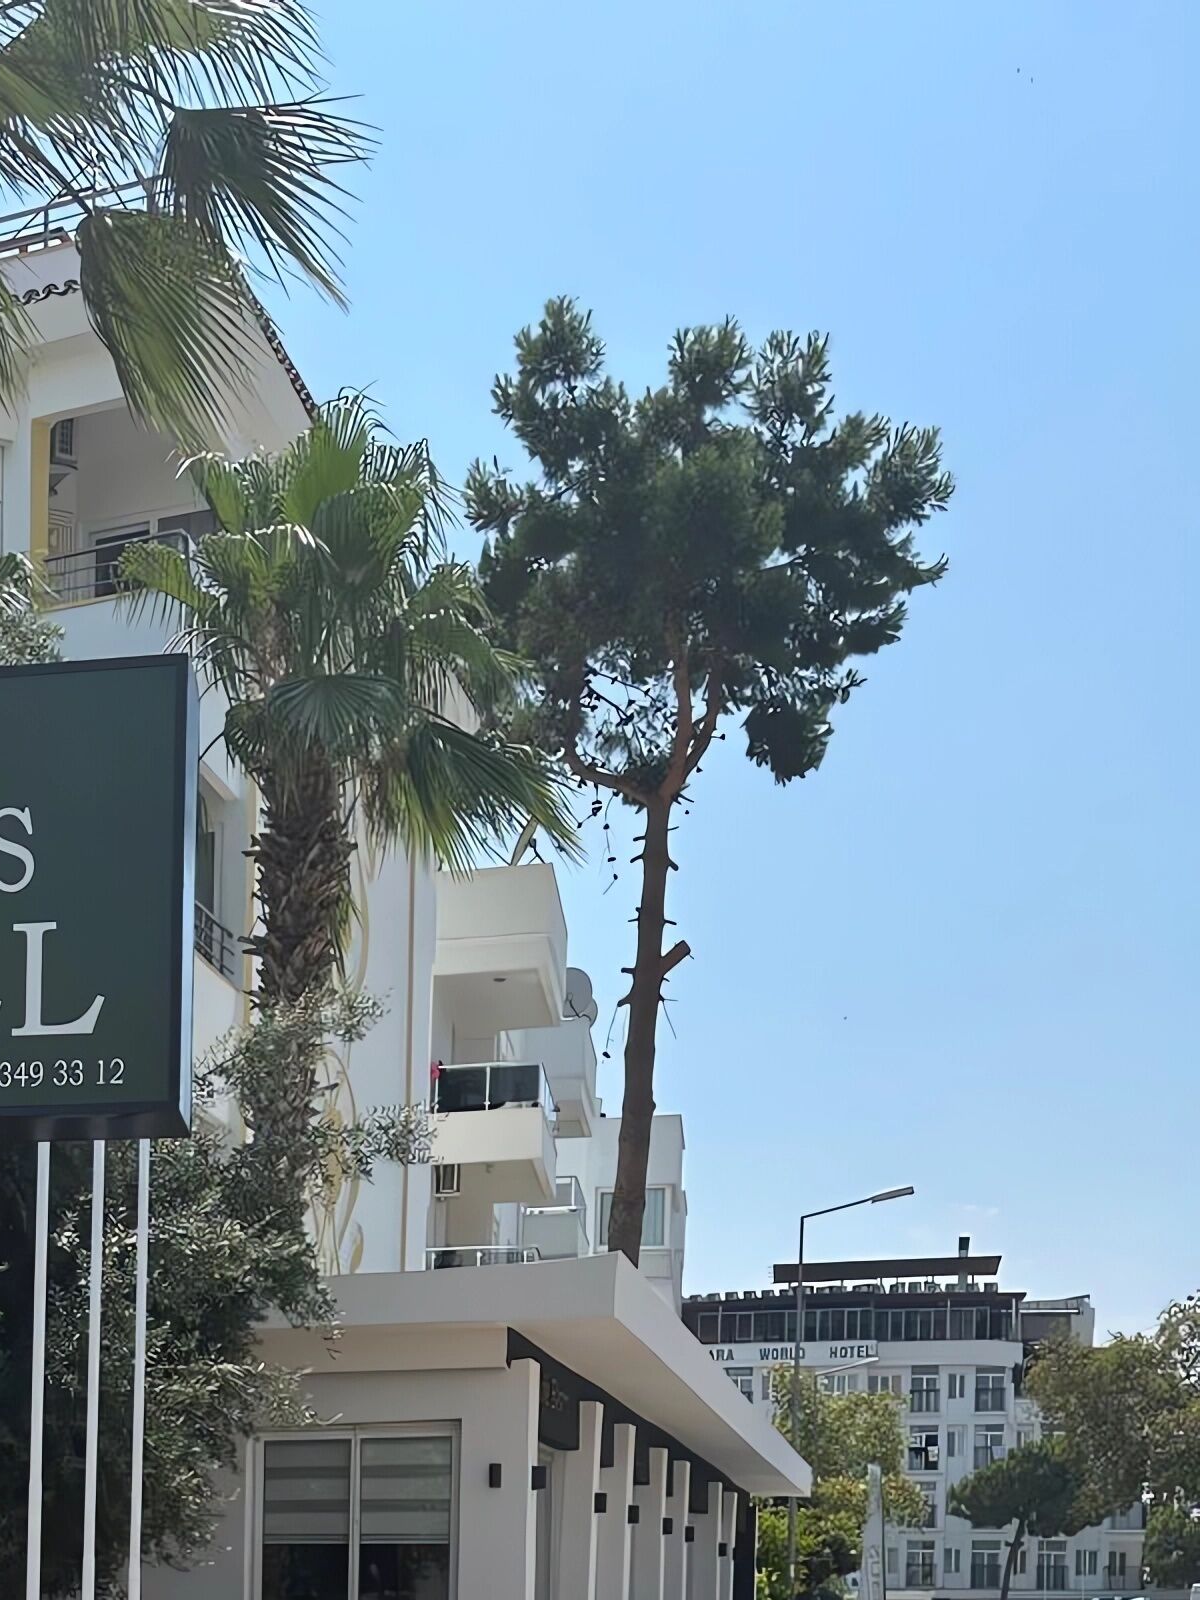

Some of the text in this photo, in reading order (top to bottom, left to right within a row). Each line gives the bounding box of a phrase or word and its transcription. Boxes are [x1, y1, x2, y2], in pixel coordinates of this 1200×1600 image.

[52, 1059, 84, 1086] 33
[96, 1057, 125, 1085] 12
[829, 1345, 874, 1359] HOTEL
